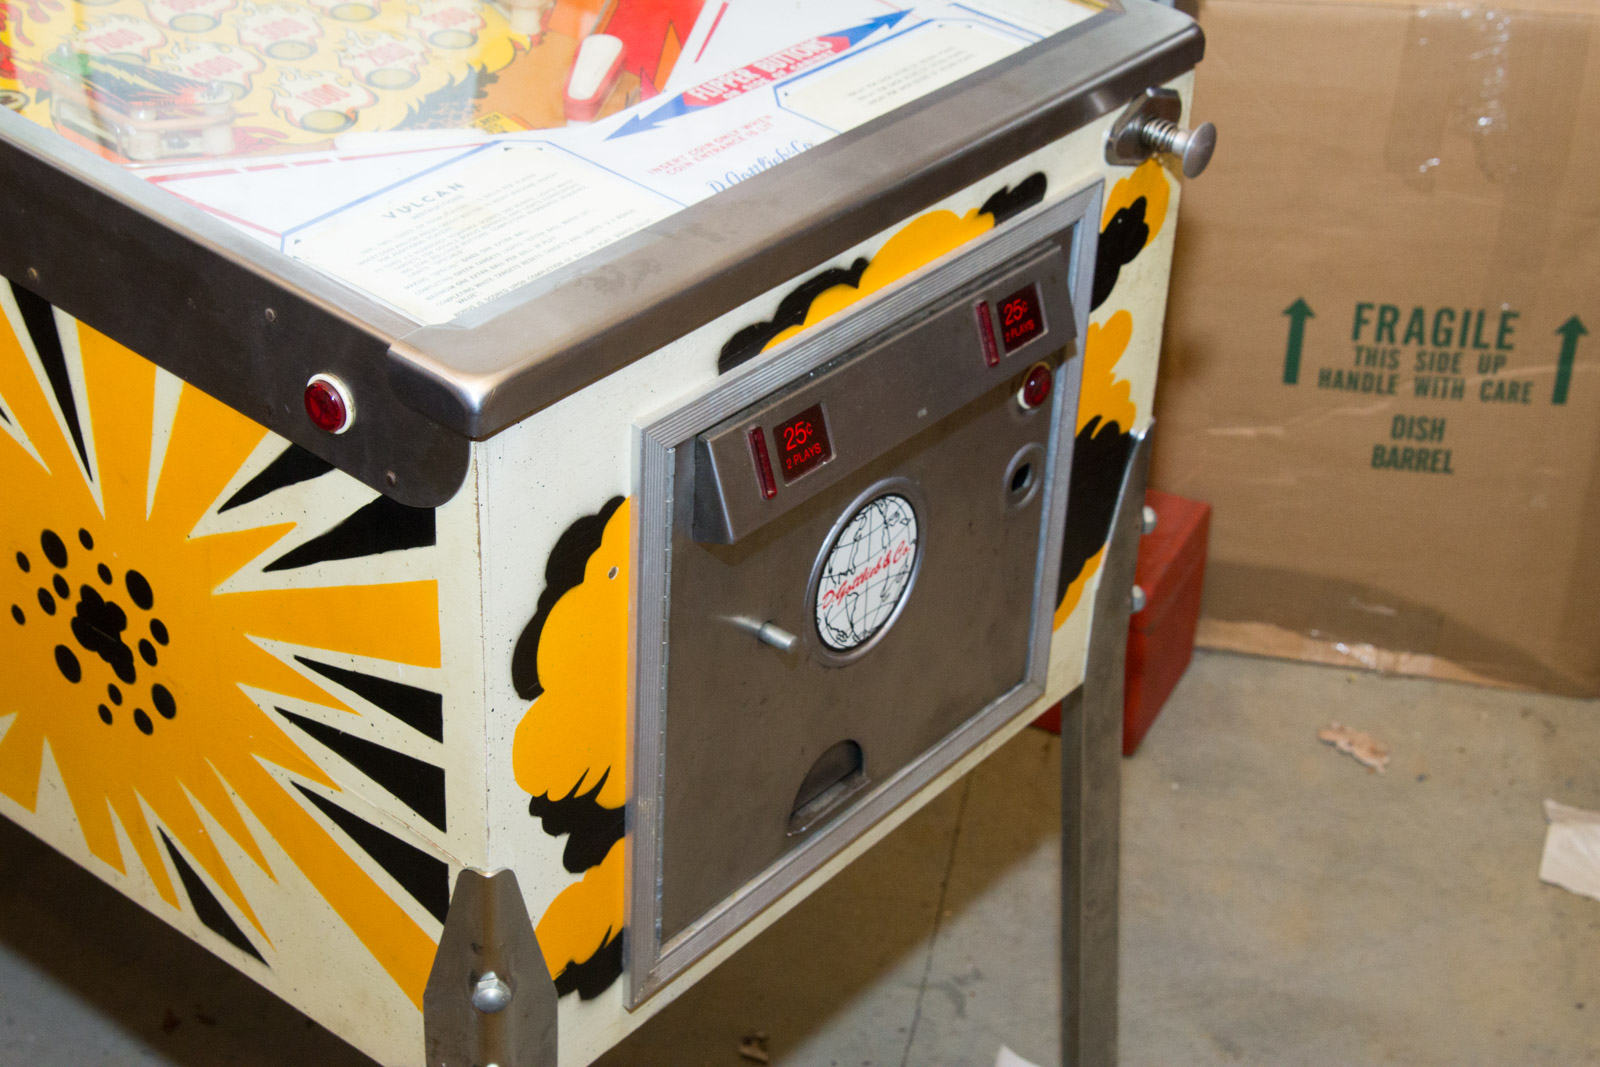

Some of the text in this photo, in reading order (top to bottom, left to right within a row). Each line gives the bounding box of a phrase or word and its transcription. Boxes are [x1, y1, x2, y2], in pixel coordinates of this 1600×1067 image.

[686, 67, 761, 101] FLIPPER
[751, 38, 833, 75] BUTTONS
[296, 83, 351, 108] 1000
[648, 114, 773, 175] INSERT COIN ONLY WHEN
[666, 159, 694, 176] COIN
[693, 135, 746, 162] ENTRANCE
[382, 182, 465, 220] VULCAN
[1004, 298, 1028, 326] 25¢
[1351, 302, 1520, 351] FRAGILE
[1010, 319, 1035, 339] PLAYS
[1354, 345, 1507, 375] THIS SIDE UP
[1318, 368, 1533, 405] HANDLE WITH CARE
[783, 420, 813, 451] 25¢
[1391, 414, 1446, 443] DISH
[785, 442, 822, 470] 2 PLAYS
[1371, 444, 1454, 475] BARREL
